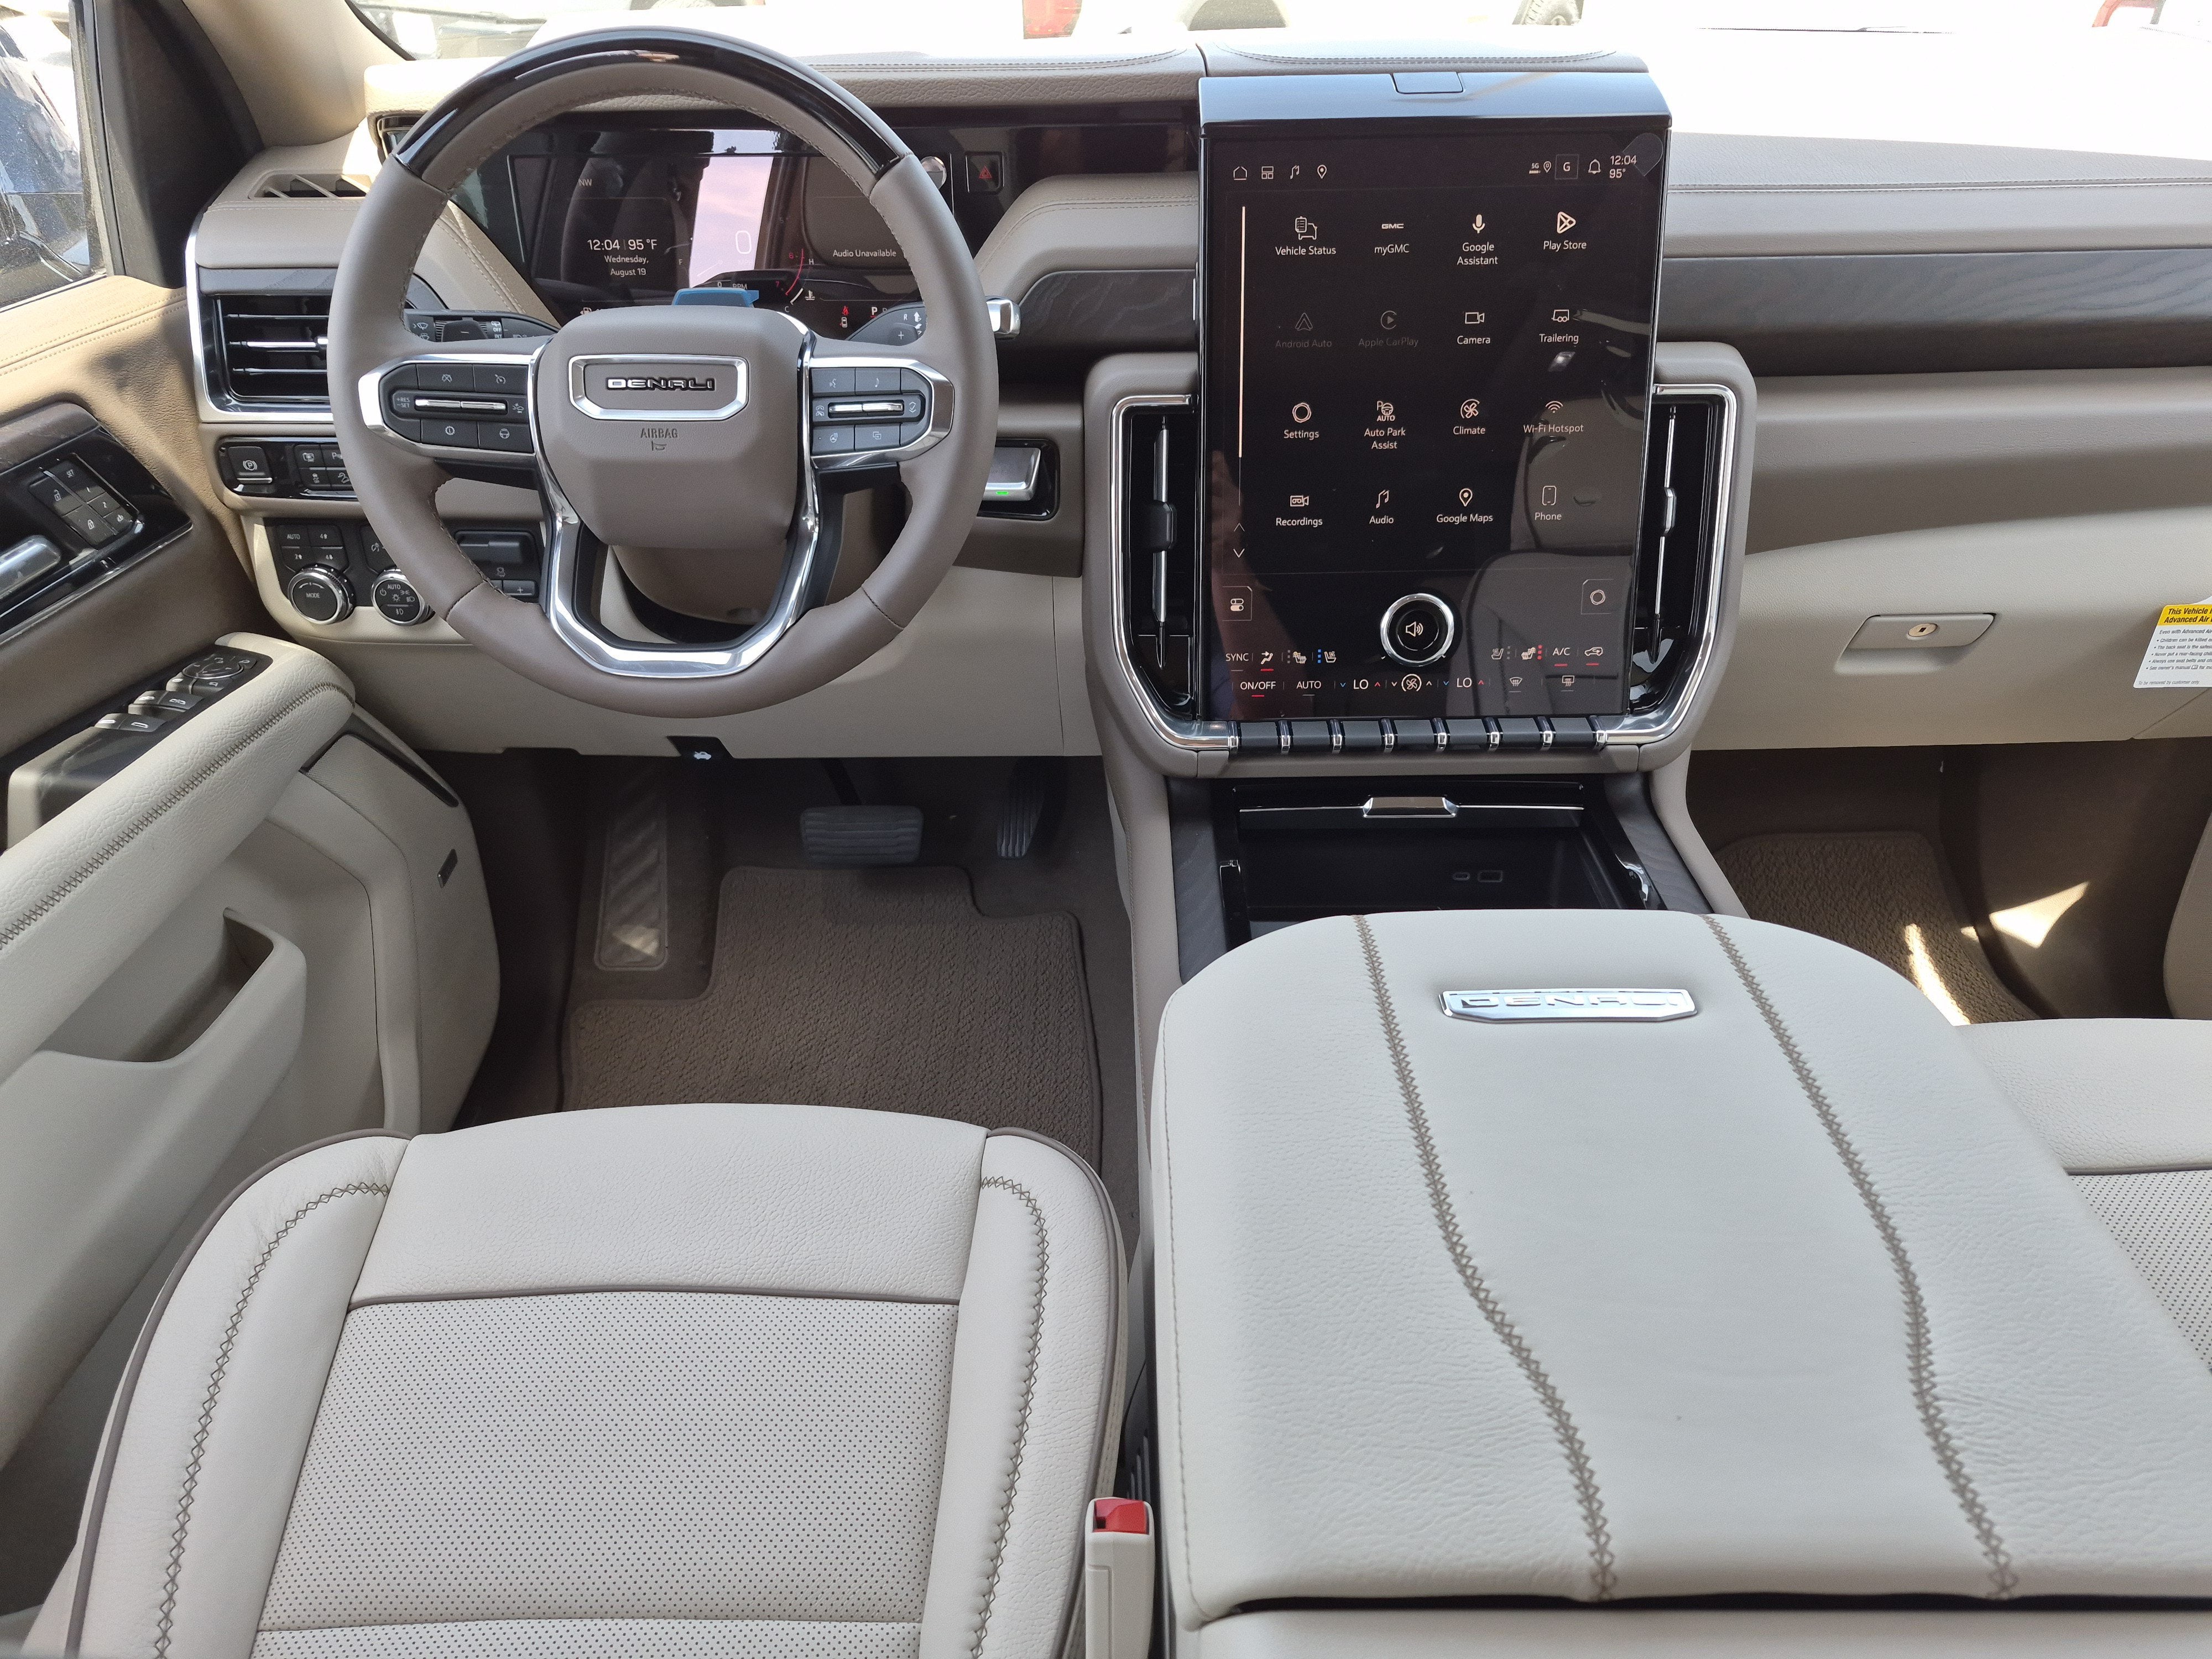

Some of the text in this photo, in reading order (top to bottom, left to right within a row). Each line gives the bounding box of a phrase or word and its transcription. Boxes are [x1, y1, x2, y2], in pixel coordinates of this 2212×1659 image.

[1610, 155, 1637, 165] 12:04
[1563, 162, 1571, 171] G
[587, 239, 620, 250] 12:04
[628, 239, 644, 250] 95
[1462, 242, 1495, 253] Google
[1543, 240, 1587, 252] Play Store
[1275, 246, 1337, 255] Vehicle Status
[1374, 244, 1410, 255] myGMC
[604, 255, 649, 264] Wednesday,
[1457, 256, 1498, 265] Assistant
[610, 268, 636, 277] August
[872, 306, 878, 315] P
[1358, 337, 1418, 348] Apple CarPlay
[1457, 336, 1490, 344] Camera
[1539, 333, 1579, 344] Trailering
[1311, 340, 1332, 348] Auto
[607, 378, 715, 390] DENALI
[640, 428, 678, 439] AIRBAG
[1364, 427, 1406, 436] Auto Park
[1453, 426, 1486, 435] Climate
[1524, 424, 1584, 434] Wi-Fi Hotspot
[1284, 429, 1319, 440] Settings
[1371, 441, 1397, 449] Assist
[1436, 514, 1493, 524] Google Maps
[1535, 512, 1562, 520] Phone
[1276, 517, 1323, 527] Recordings
[1553, 648, 1570, 656] A/C
[1225, 653, 1249, 661] SYNC
[1240, 681, 1276, 690] ON/OFF
[1296, 681, 1321, 689] AUTO
[1353, 679, 1369, 689] LO
[1457, 678, 1472, 687] LO
